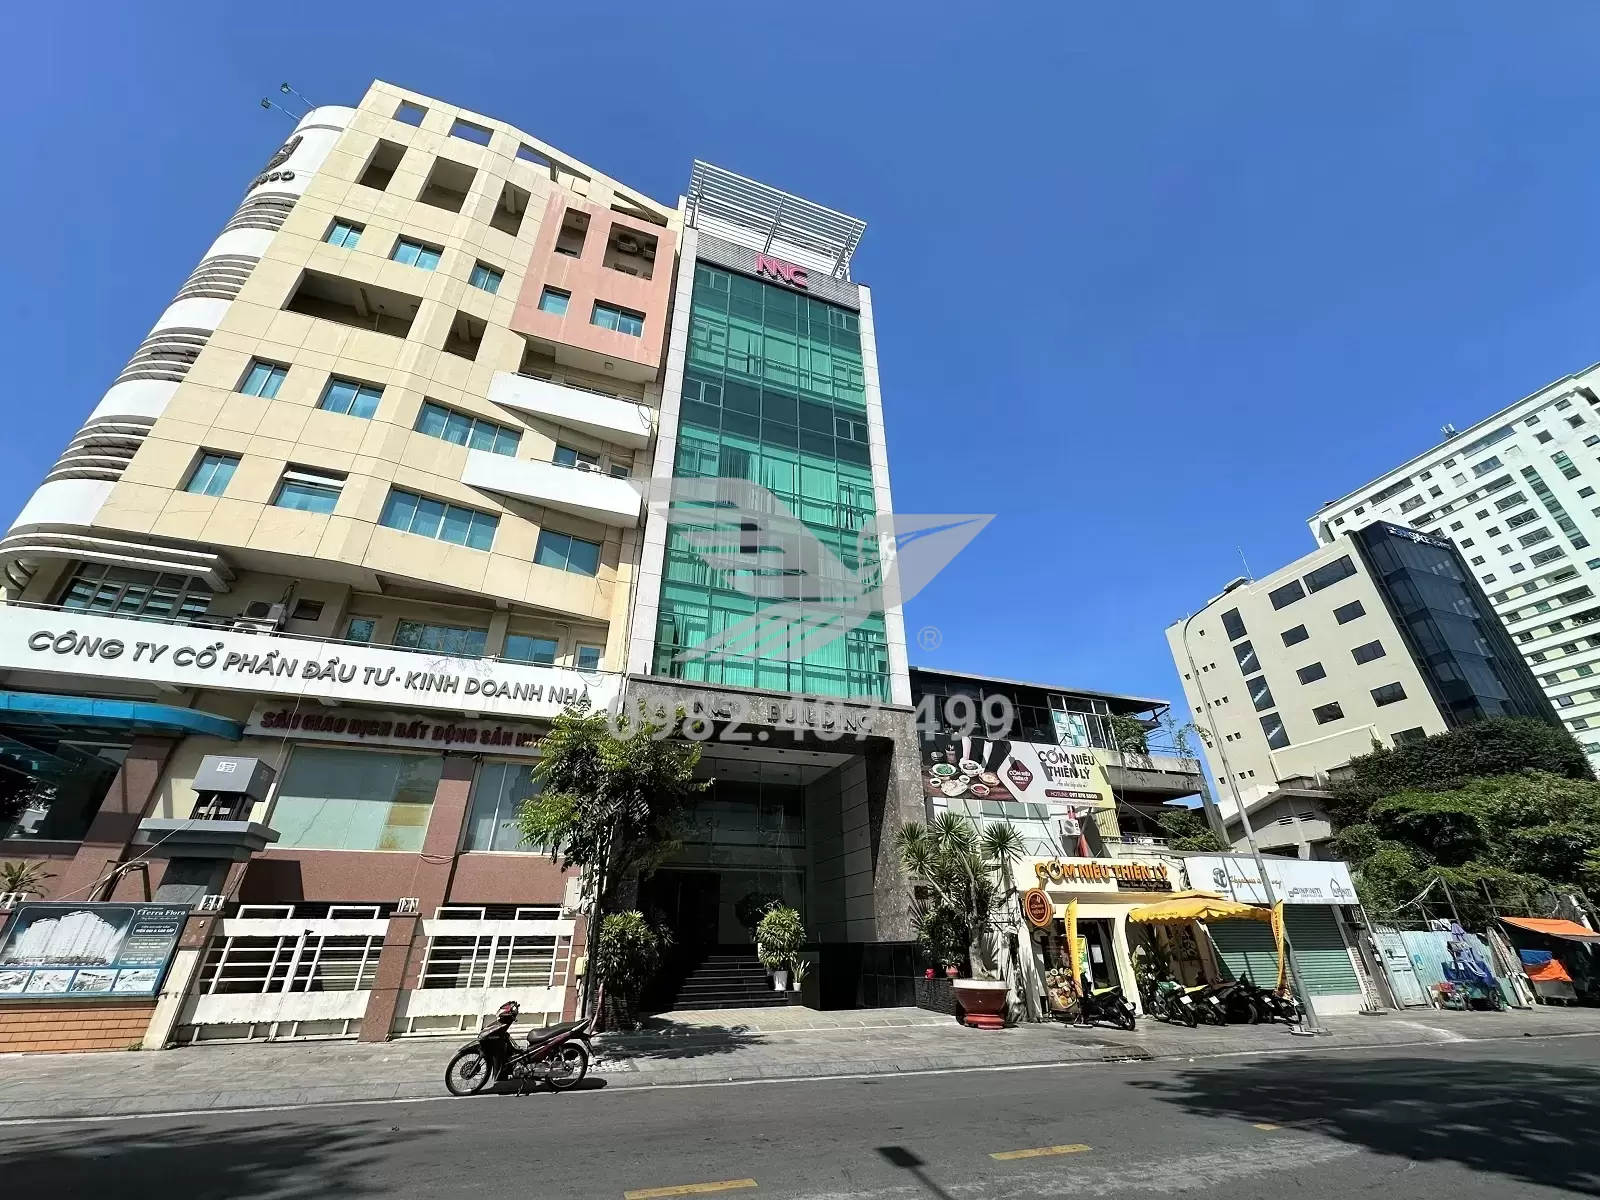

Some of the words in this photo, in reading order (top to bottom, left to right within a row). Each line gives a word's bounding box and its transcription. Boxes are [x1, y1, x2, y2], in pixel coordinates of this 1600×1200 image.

[756, 252, 807, 287] NNC
[28, 630, 124, 659] CÔNG
[133, 641, 168, 663] TY
[173, 641, 224, 669] CỔ
[222, 650, 298, 677] PHẦN
[302, 656, 357, 682] ĐẦU
[363, 666, 395, 686] TƯ
[404, 670, 459, 693] KINH
[464, 679, 543, 702] DOANH
[548, 684, 592, 706] NHÀ
[301, 714, 347, 733] GIAO
[767, 701, 873, 733] BUILDING
[1038, 747, 1070, 764] CƠM
[1071, 753, 1095, 766] NIÊU
[1035, 856, 1077, 880] CƠM
[1077, 861, 1110, 880] NIÊU
[1111, 862, 1152, 880] THIÊN
